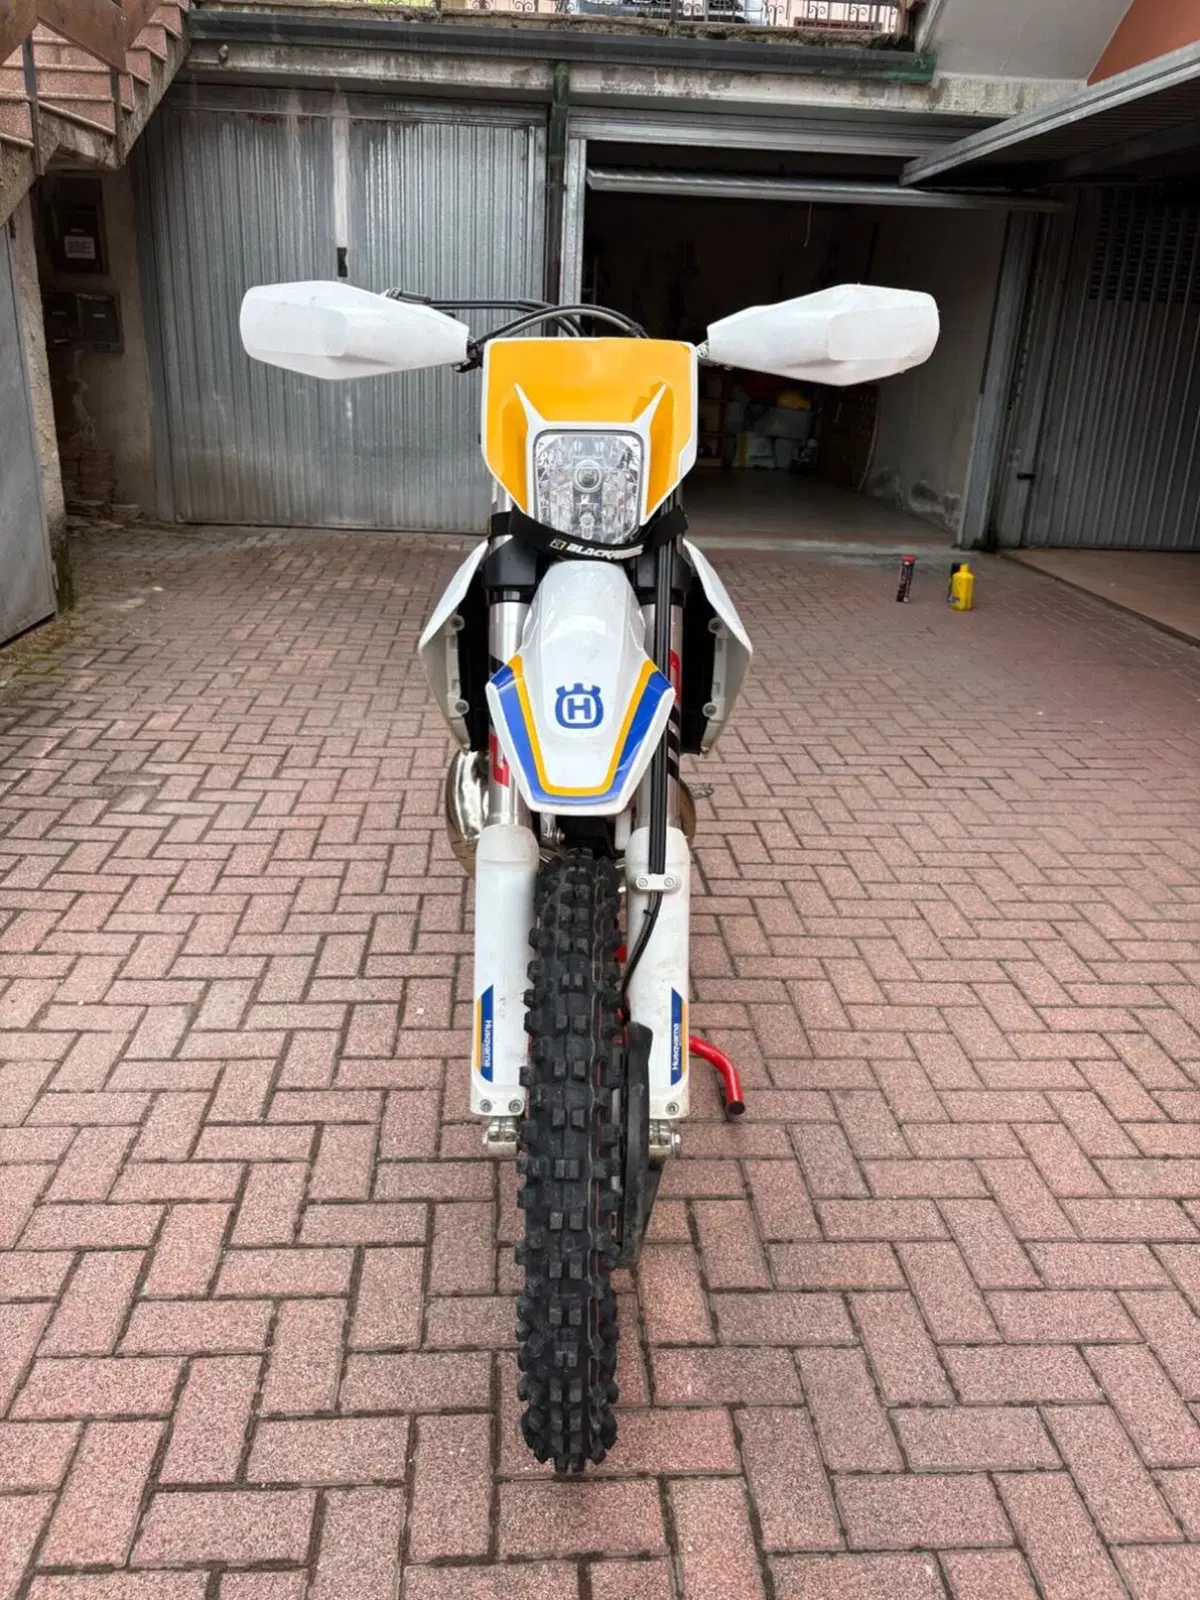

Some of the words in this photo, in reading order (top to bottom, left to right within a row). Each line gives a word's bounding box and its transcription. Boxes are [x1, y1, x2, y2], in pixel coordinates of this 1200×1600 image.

[567, 698, 592, 720] H
[482, 1019, 493, 1068] Husqvarna
[672, 1022, 681, 1071] Husqvarna
